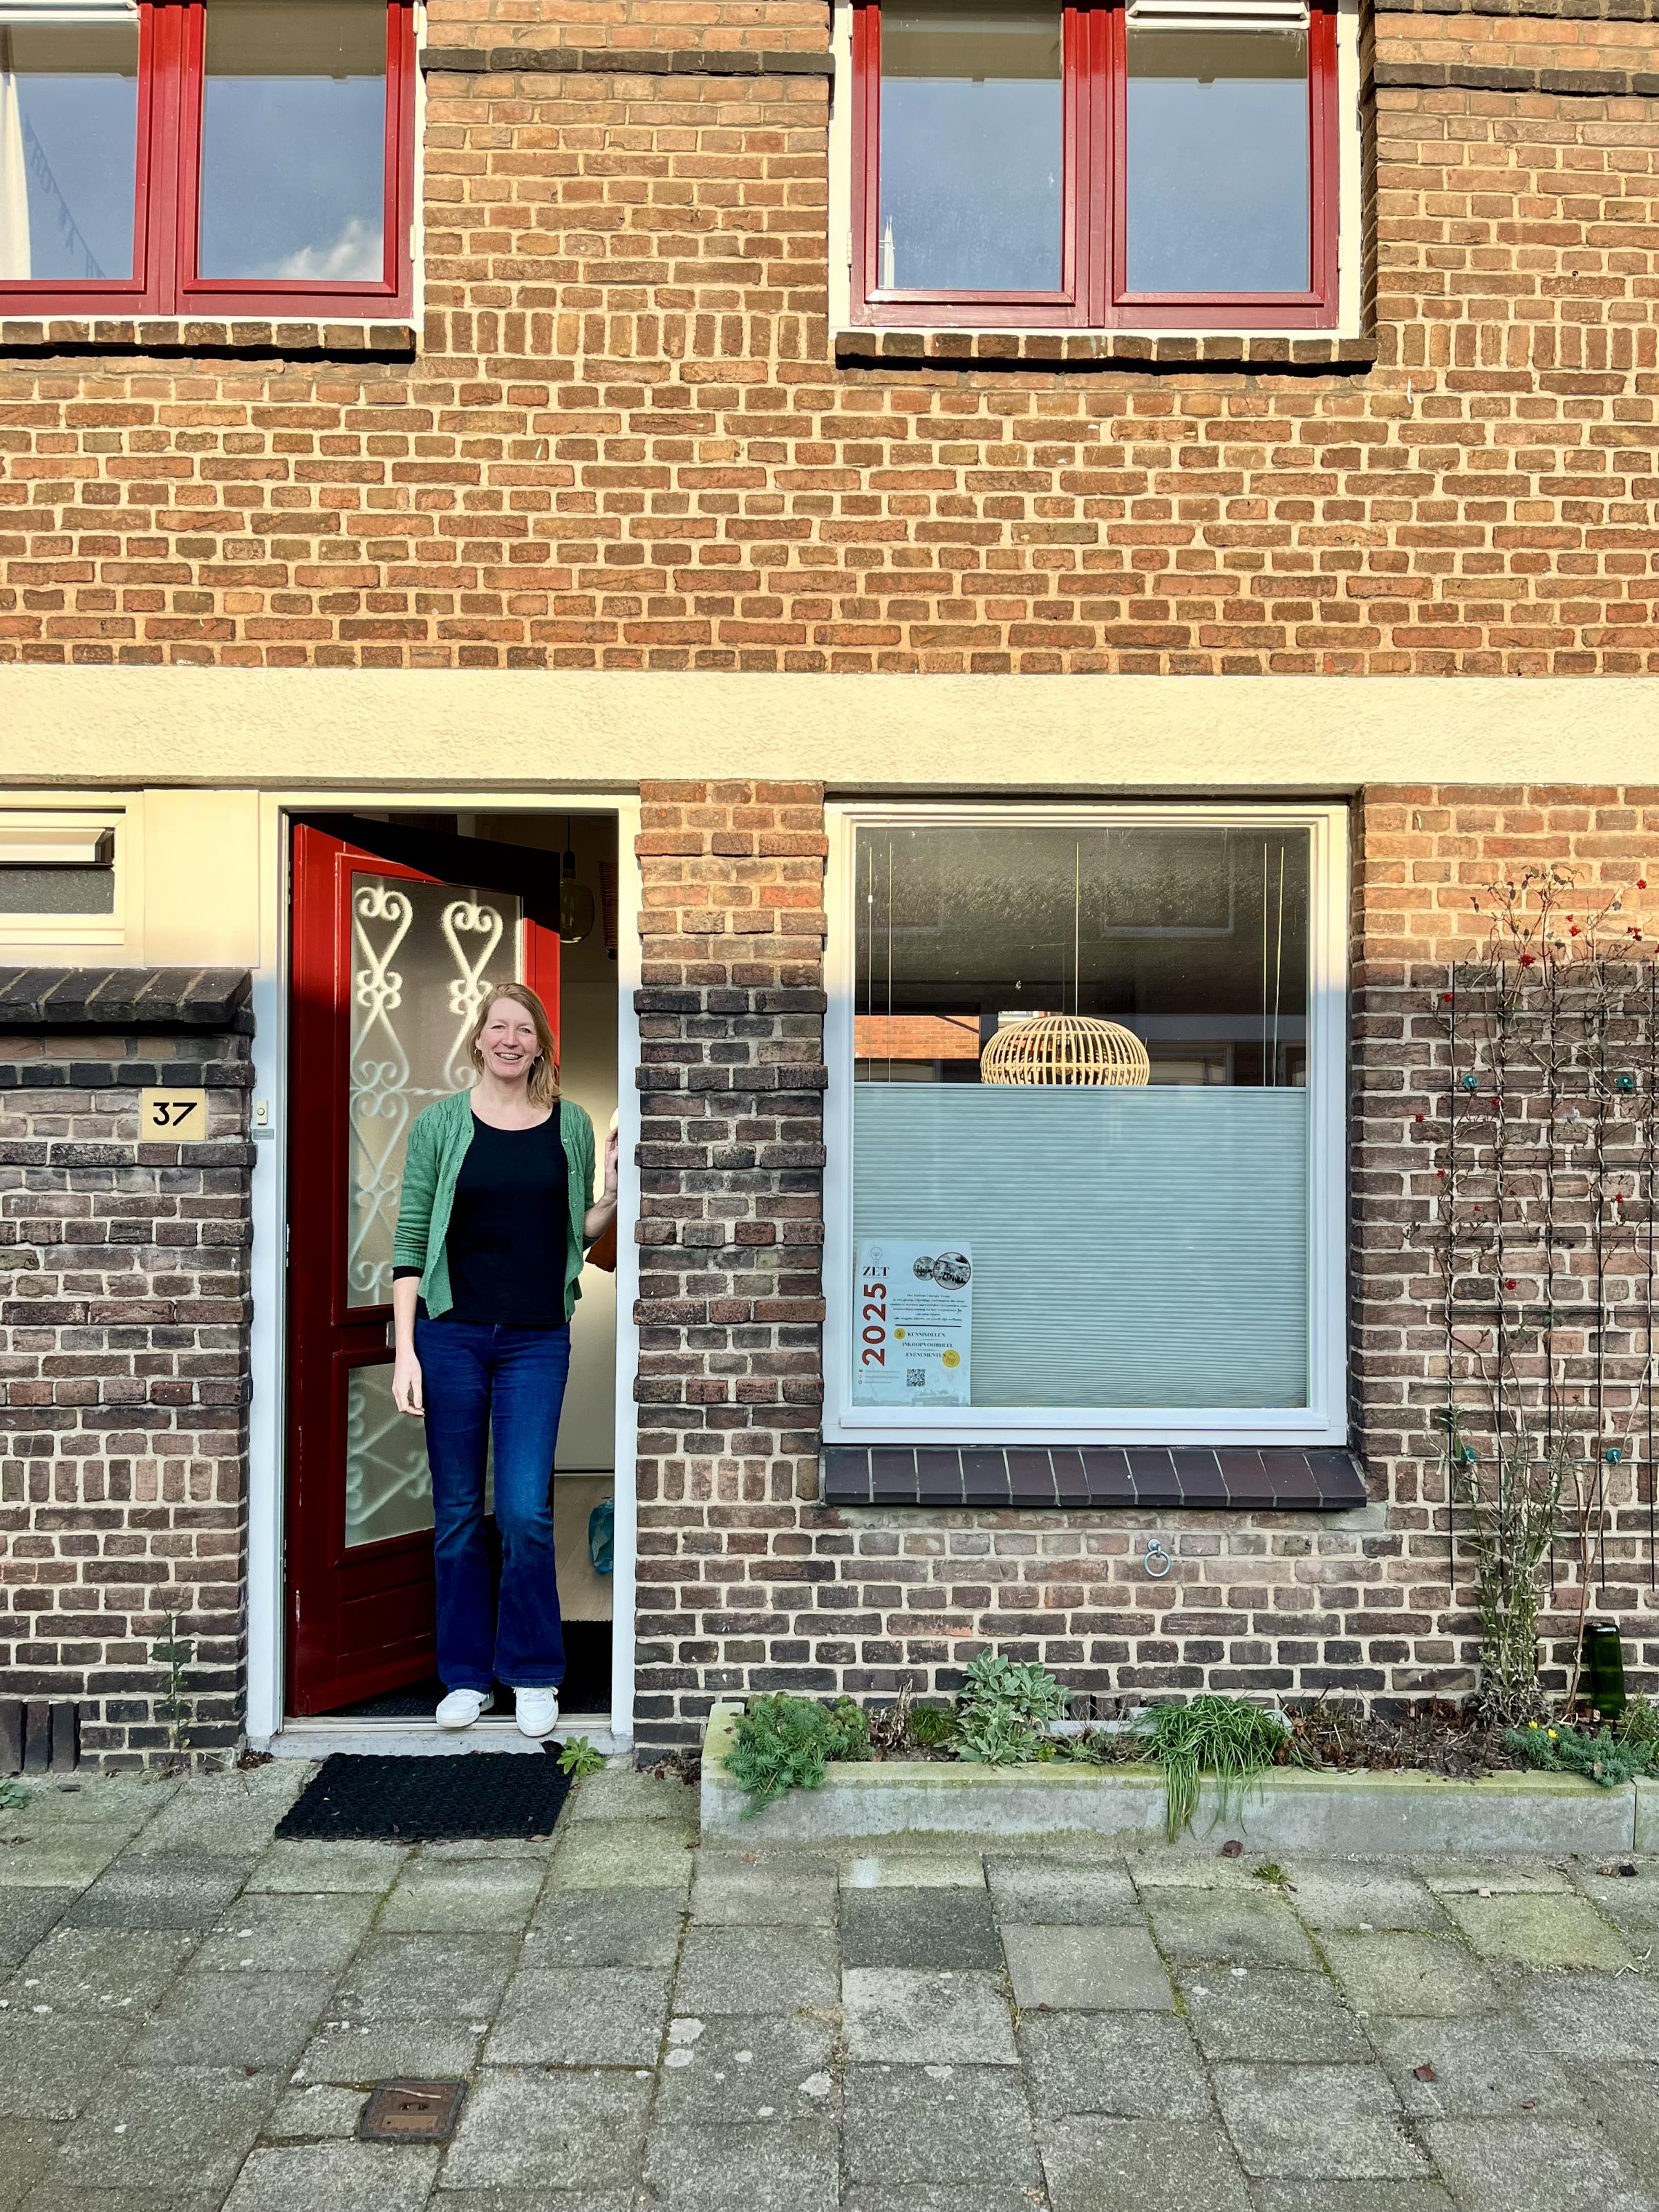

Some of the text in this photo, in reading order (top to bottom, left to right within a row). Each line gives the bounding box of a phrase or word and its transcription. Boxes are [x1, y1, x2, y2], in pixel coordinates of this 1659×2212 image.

[153, 1102, 198, 1126] 37
[863, 1266, 890, 1276] ZET
[862, 1283, 887, 1367] 2025
